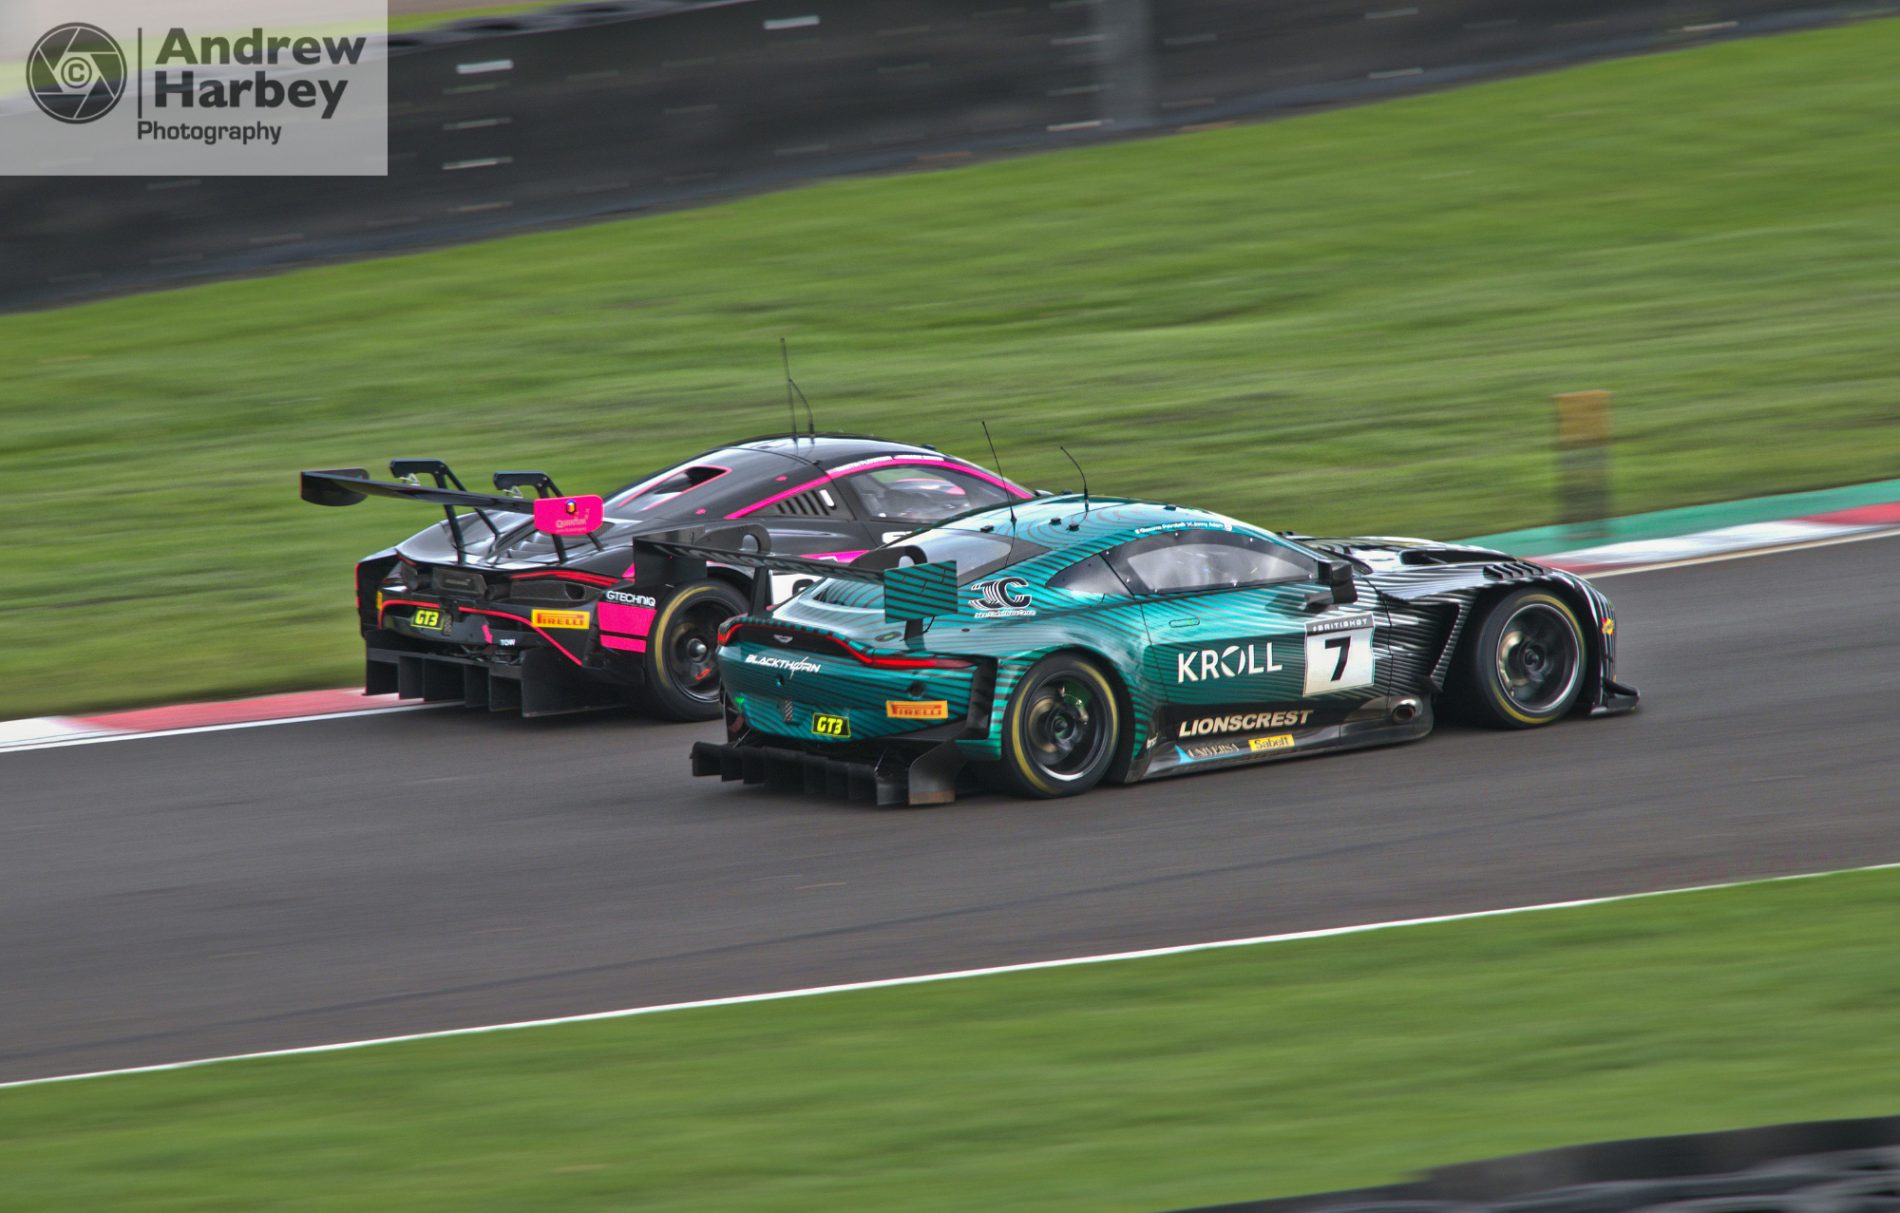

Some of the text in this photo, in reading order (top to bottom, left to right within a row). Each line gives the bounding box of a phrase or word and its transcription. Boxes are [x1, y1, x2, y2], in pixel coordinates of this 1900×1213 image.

[605, 590, 656, 607] GTECHNIQ
[414, 609, 440, 627] GT3
[536, 612, 585, 626] PIRELLI
[744, 653, 822, 675] BLACKTHORN
[1177, 641, 1283, 684] KROLL
[1324, 636, 1351, 682] 7
[891, 703, 943, 716] PIRELLI
[816, 715, 843, 735] GT3
[1178, 708, 1315, 738] LIONSCREST
